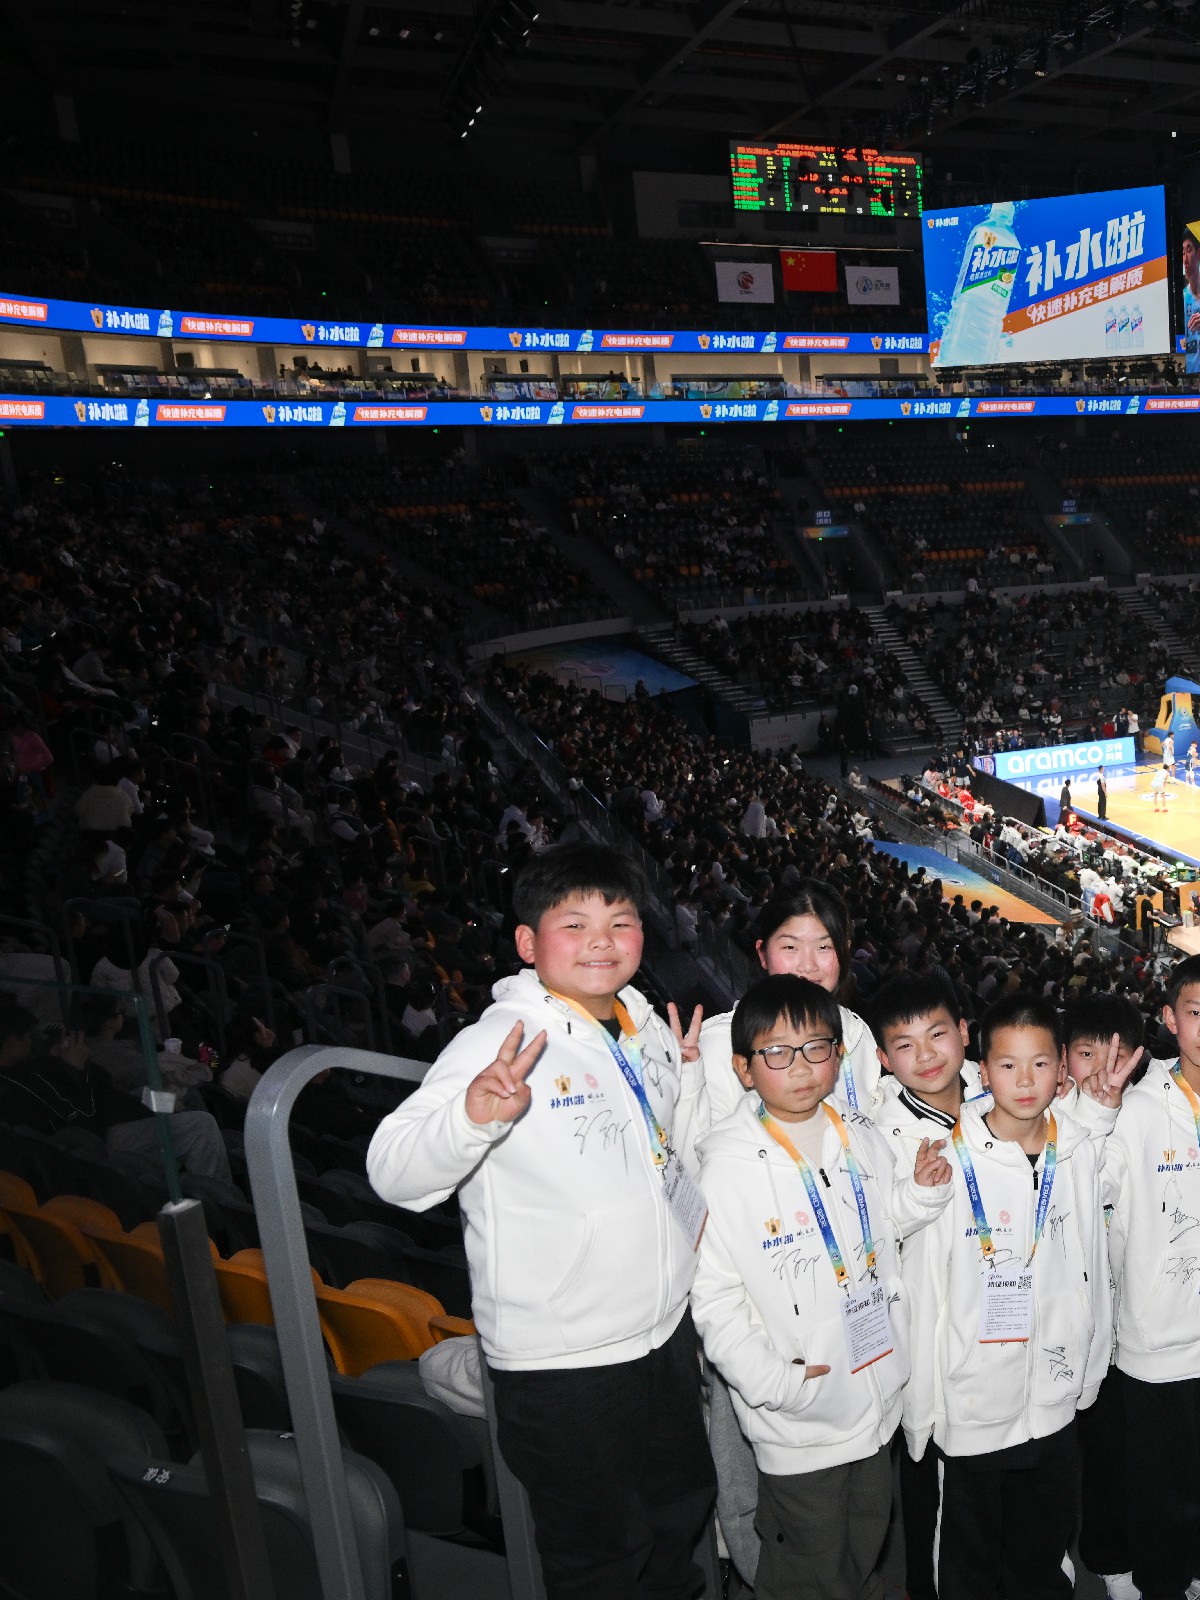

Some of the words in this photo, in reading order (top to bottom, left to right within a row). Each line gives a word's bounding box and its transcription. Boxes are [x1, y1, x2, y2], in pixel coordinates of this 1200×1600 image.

[971, 247, 1019, 272] 补水啦
[1025, 210, 1145, 297] 补水啦
[1030, 267, 1142, 324] 快速补充电解质
[106, 311, 149, 329] 补水啦
[187, 318, 250, 334] 快速补充电解质
[319, 326, 359, 341] 补水啦
[399, 330, 462, 343] 快速补充电解质
[525, 333, 569, 346] 补水啦
[607, 335, 669, 346] 快速补充电解质
[713, 336, 754, 348] 补水啦
[789, 337, 845, 347] 快速补充电解质
[885, 337, 922, 349] 补水啦
[88, 403, 127, 420] 补水啦
[716, 405, 756, 417] 补水啦
[914, 403, 951, 414] 补水啦
[1088, 400, 1121, 411] 补水啦
[162, 408, 222, 419] 快速补充电解质
[278, 406, 322, 421] 补水啦
[360, 408, 423, 419] 快速补充电解质
[496, 407, 540, 420] 补水啦
[1008, 746, 1103, 774] aramco
